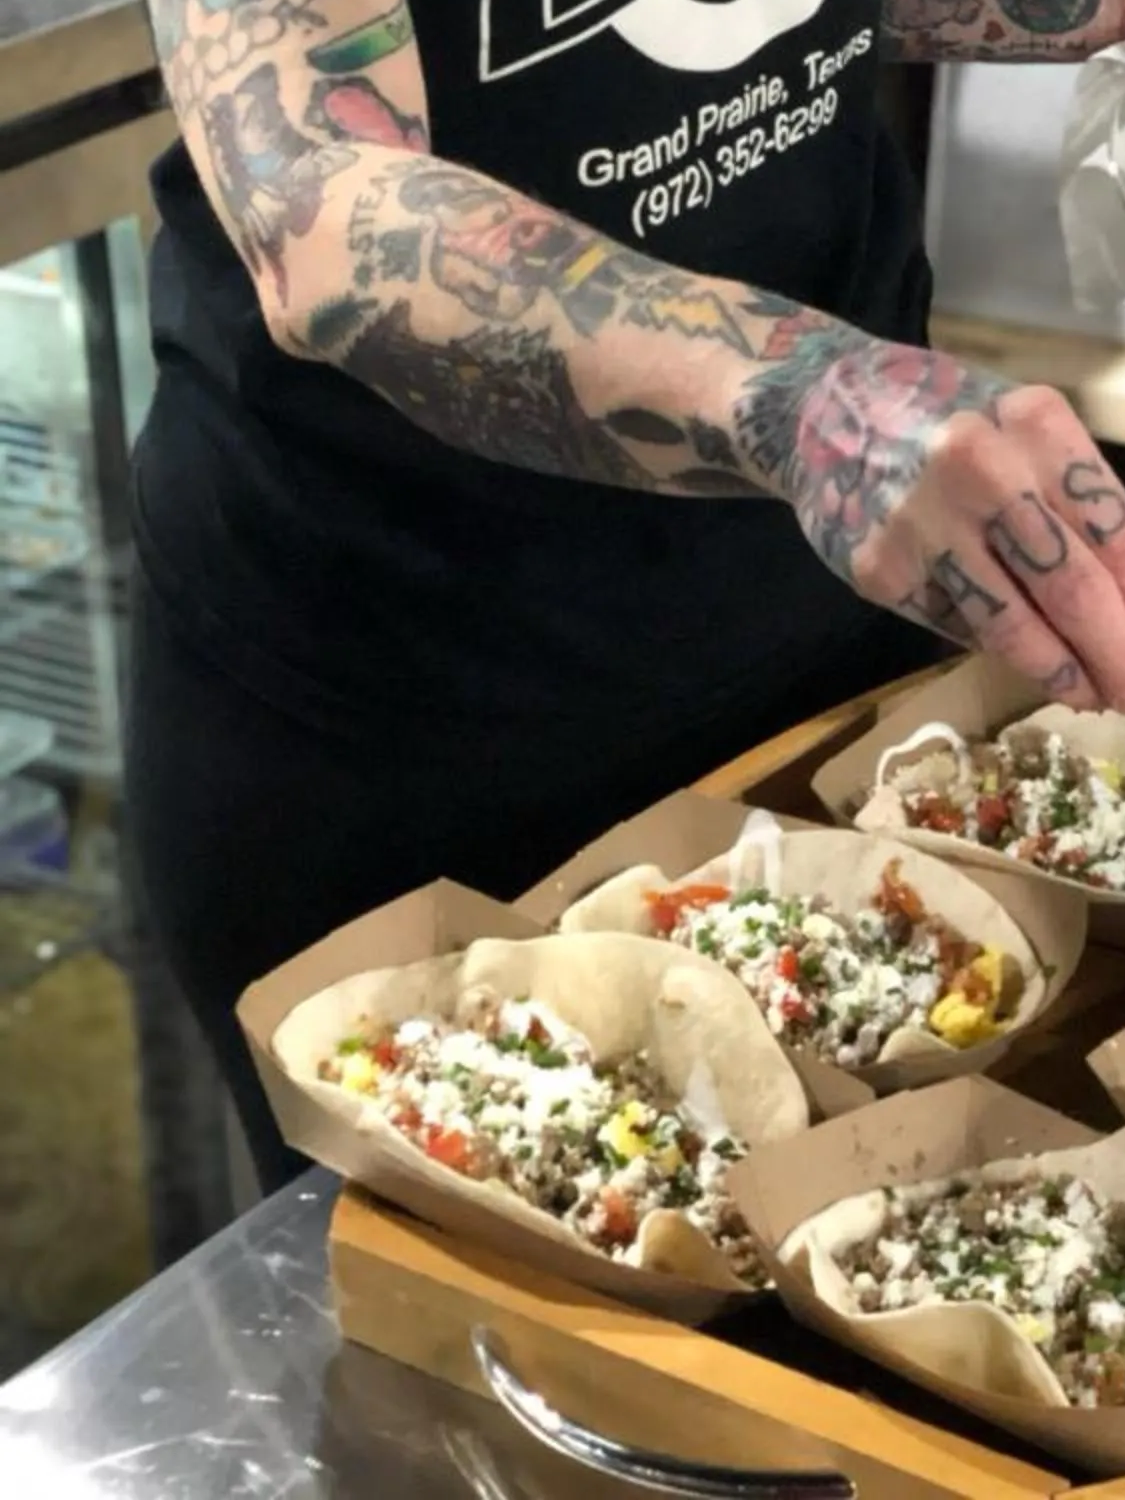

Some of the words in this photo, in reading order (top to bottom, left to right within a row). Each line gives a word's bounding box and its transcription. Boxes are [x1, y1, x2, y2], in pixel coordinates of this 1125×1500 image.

[577, 115, 689, 187] Grand
[695, 74, 789, 146] Prairie,
[631, 158, 713, 238] (972)
[716, 87, 838, 187] 352-6299
